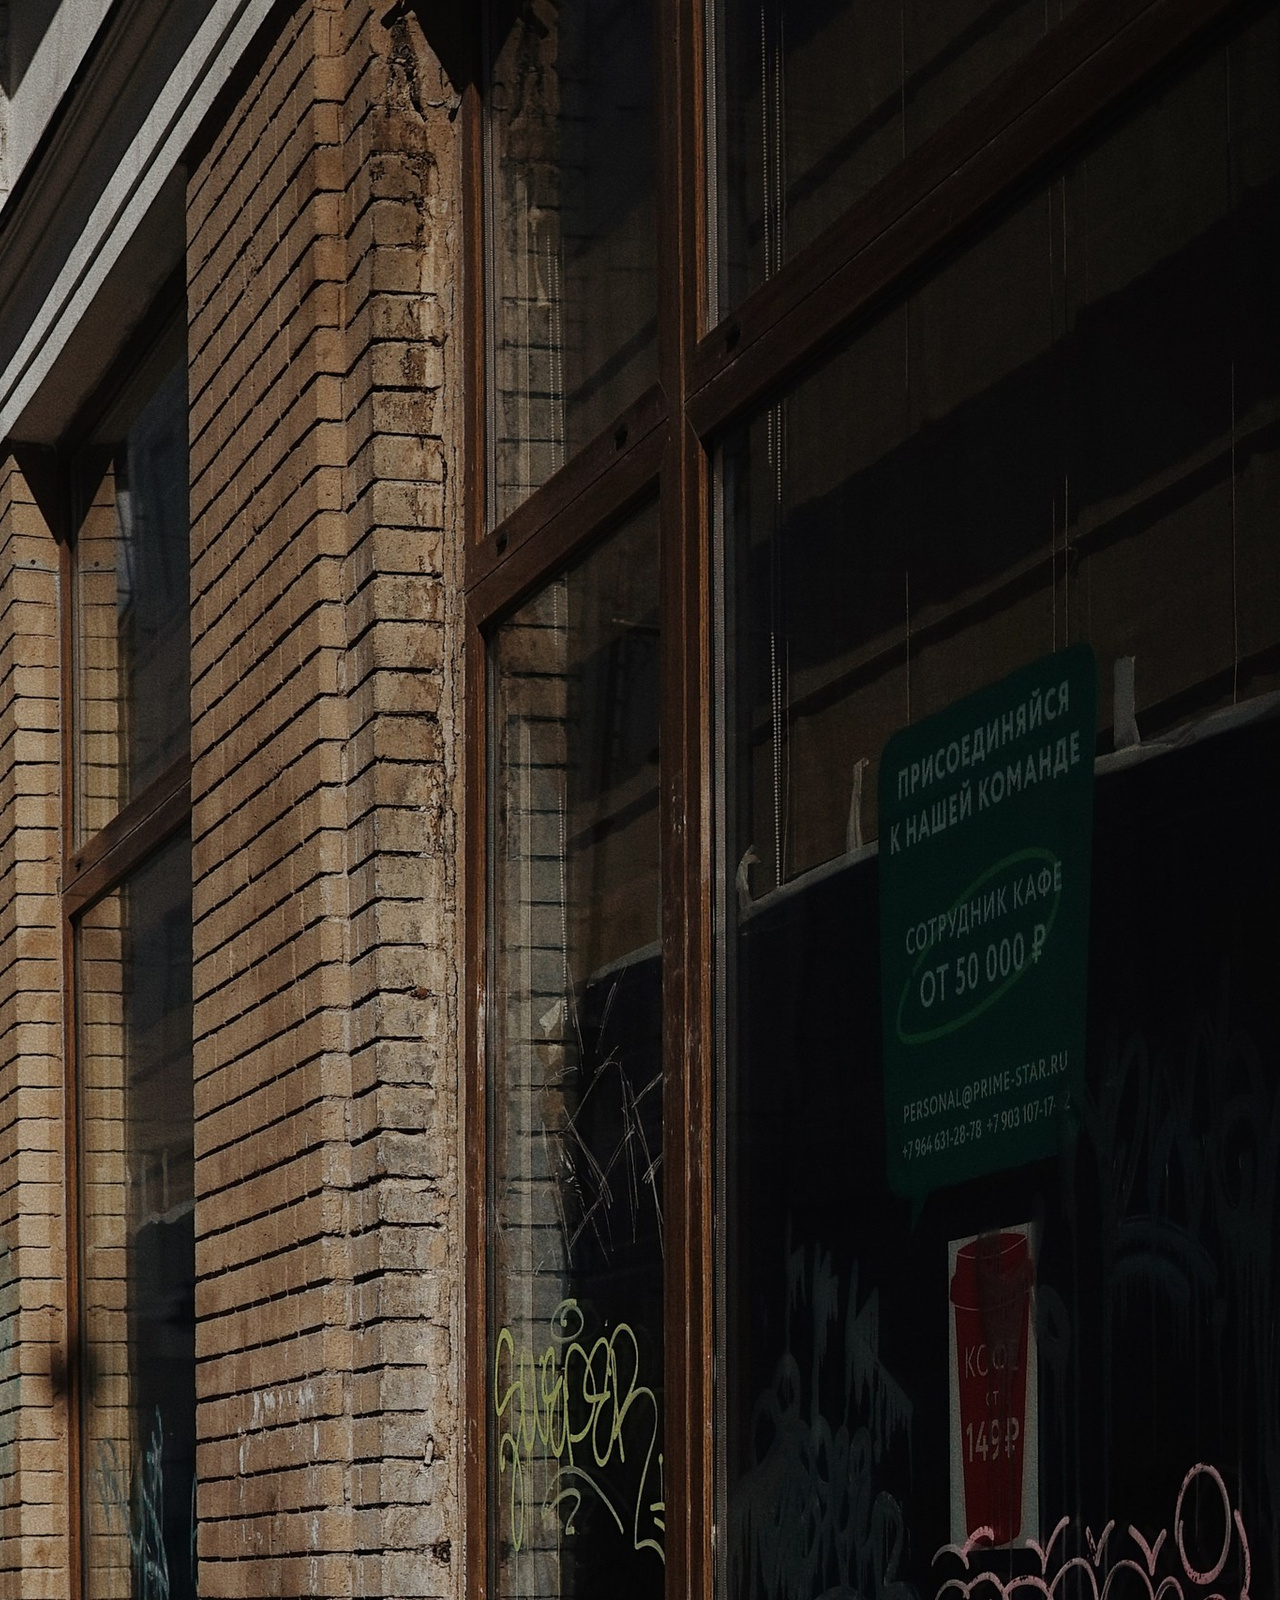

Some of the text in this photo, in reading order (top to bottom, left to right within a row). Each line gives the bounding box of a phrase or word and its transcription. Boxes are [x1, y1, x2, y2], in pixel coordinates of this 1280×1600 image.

[898, 679, 1069, 801] ПРИСОЕДИНЯЙСЯ
[890, 730, 1080, 855] К НАШЕЙ КОМАНДЕ
[905, 860, 1063, 955] СОТРУДНИК КАФЕ
[920, 962, 950, 1008] ОТ
[955, 952, 979, 996] 50
[985, 931, 1025, 983] 000
[903, 1049, 1069, 1124] PERSONAL@PRIME-STAR.RU
